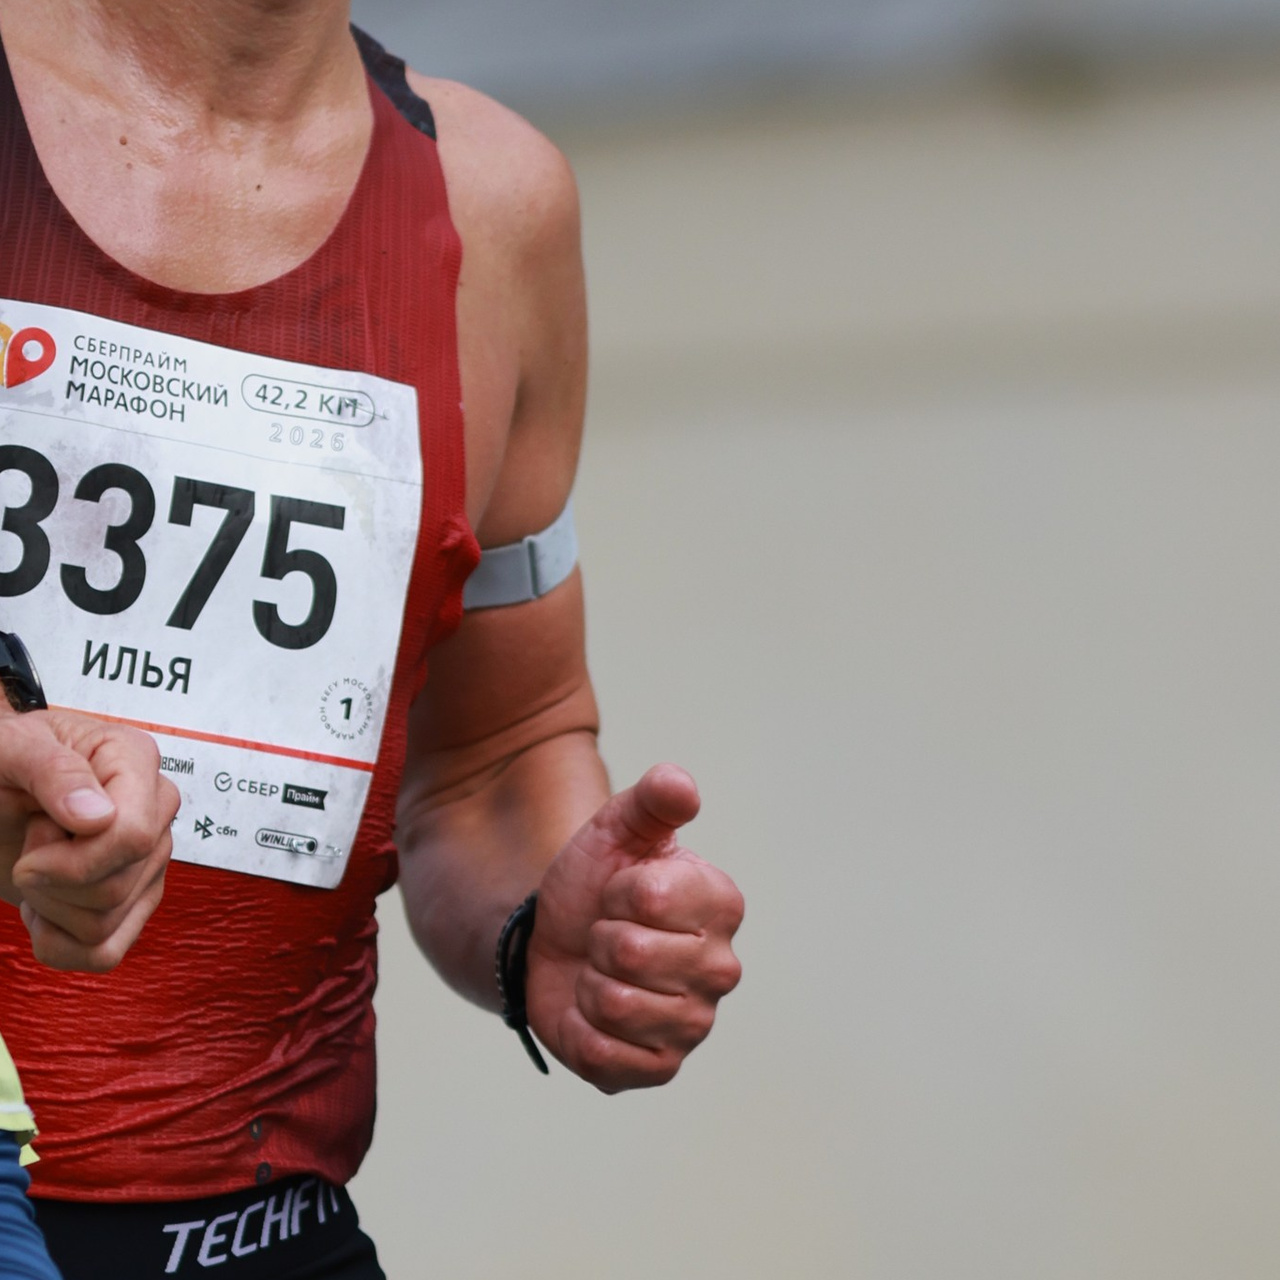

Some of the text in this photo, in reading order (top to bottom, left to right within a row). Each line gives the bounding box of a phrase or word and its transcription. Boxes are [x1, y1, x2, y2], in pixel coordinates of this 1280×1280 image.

[74, 335, 187, 373] СБЕРПРАЙМ
[70, 356, 228, 407] МОСКОВСКИЙ
[254, 384, 308, 411] 42,2
[65, 380, 186, 422] МАРАФОН
[268, 422, 345, 452] 2026
[81, 639, 193, 694] ИЛЬЯ
[340, 697, 352, 721] 1
[237, 779, 279, 797] СБЕР
